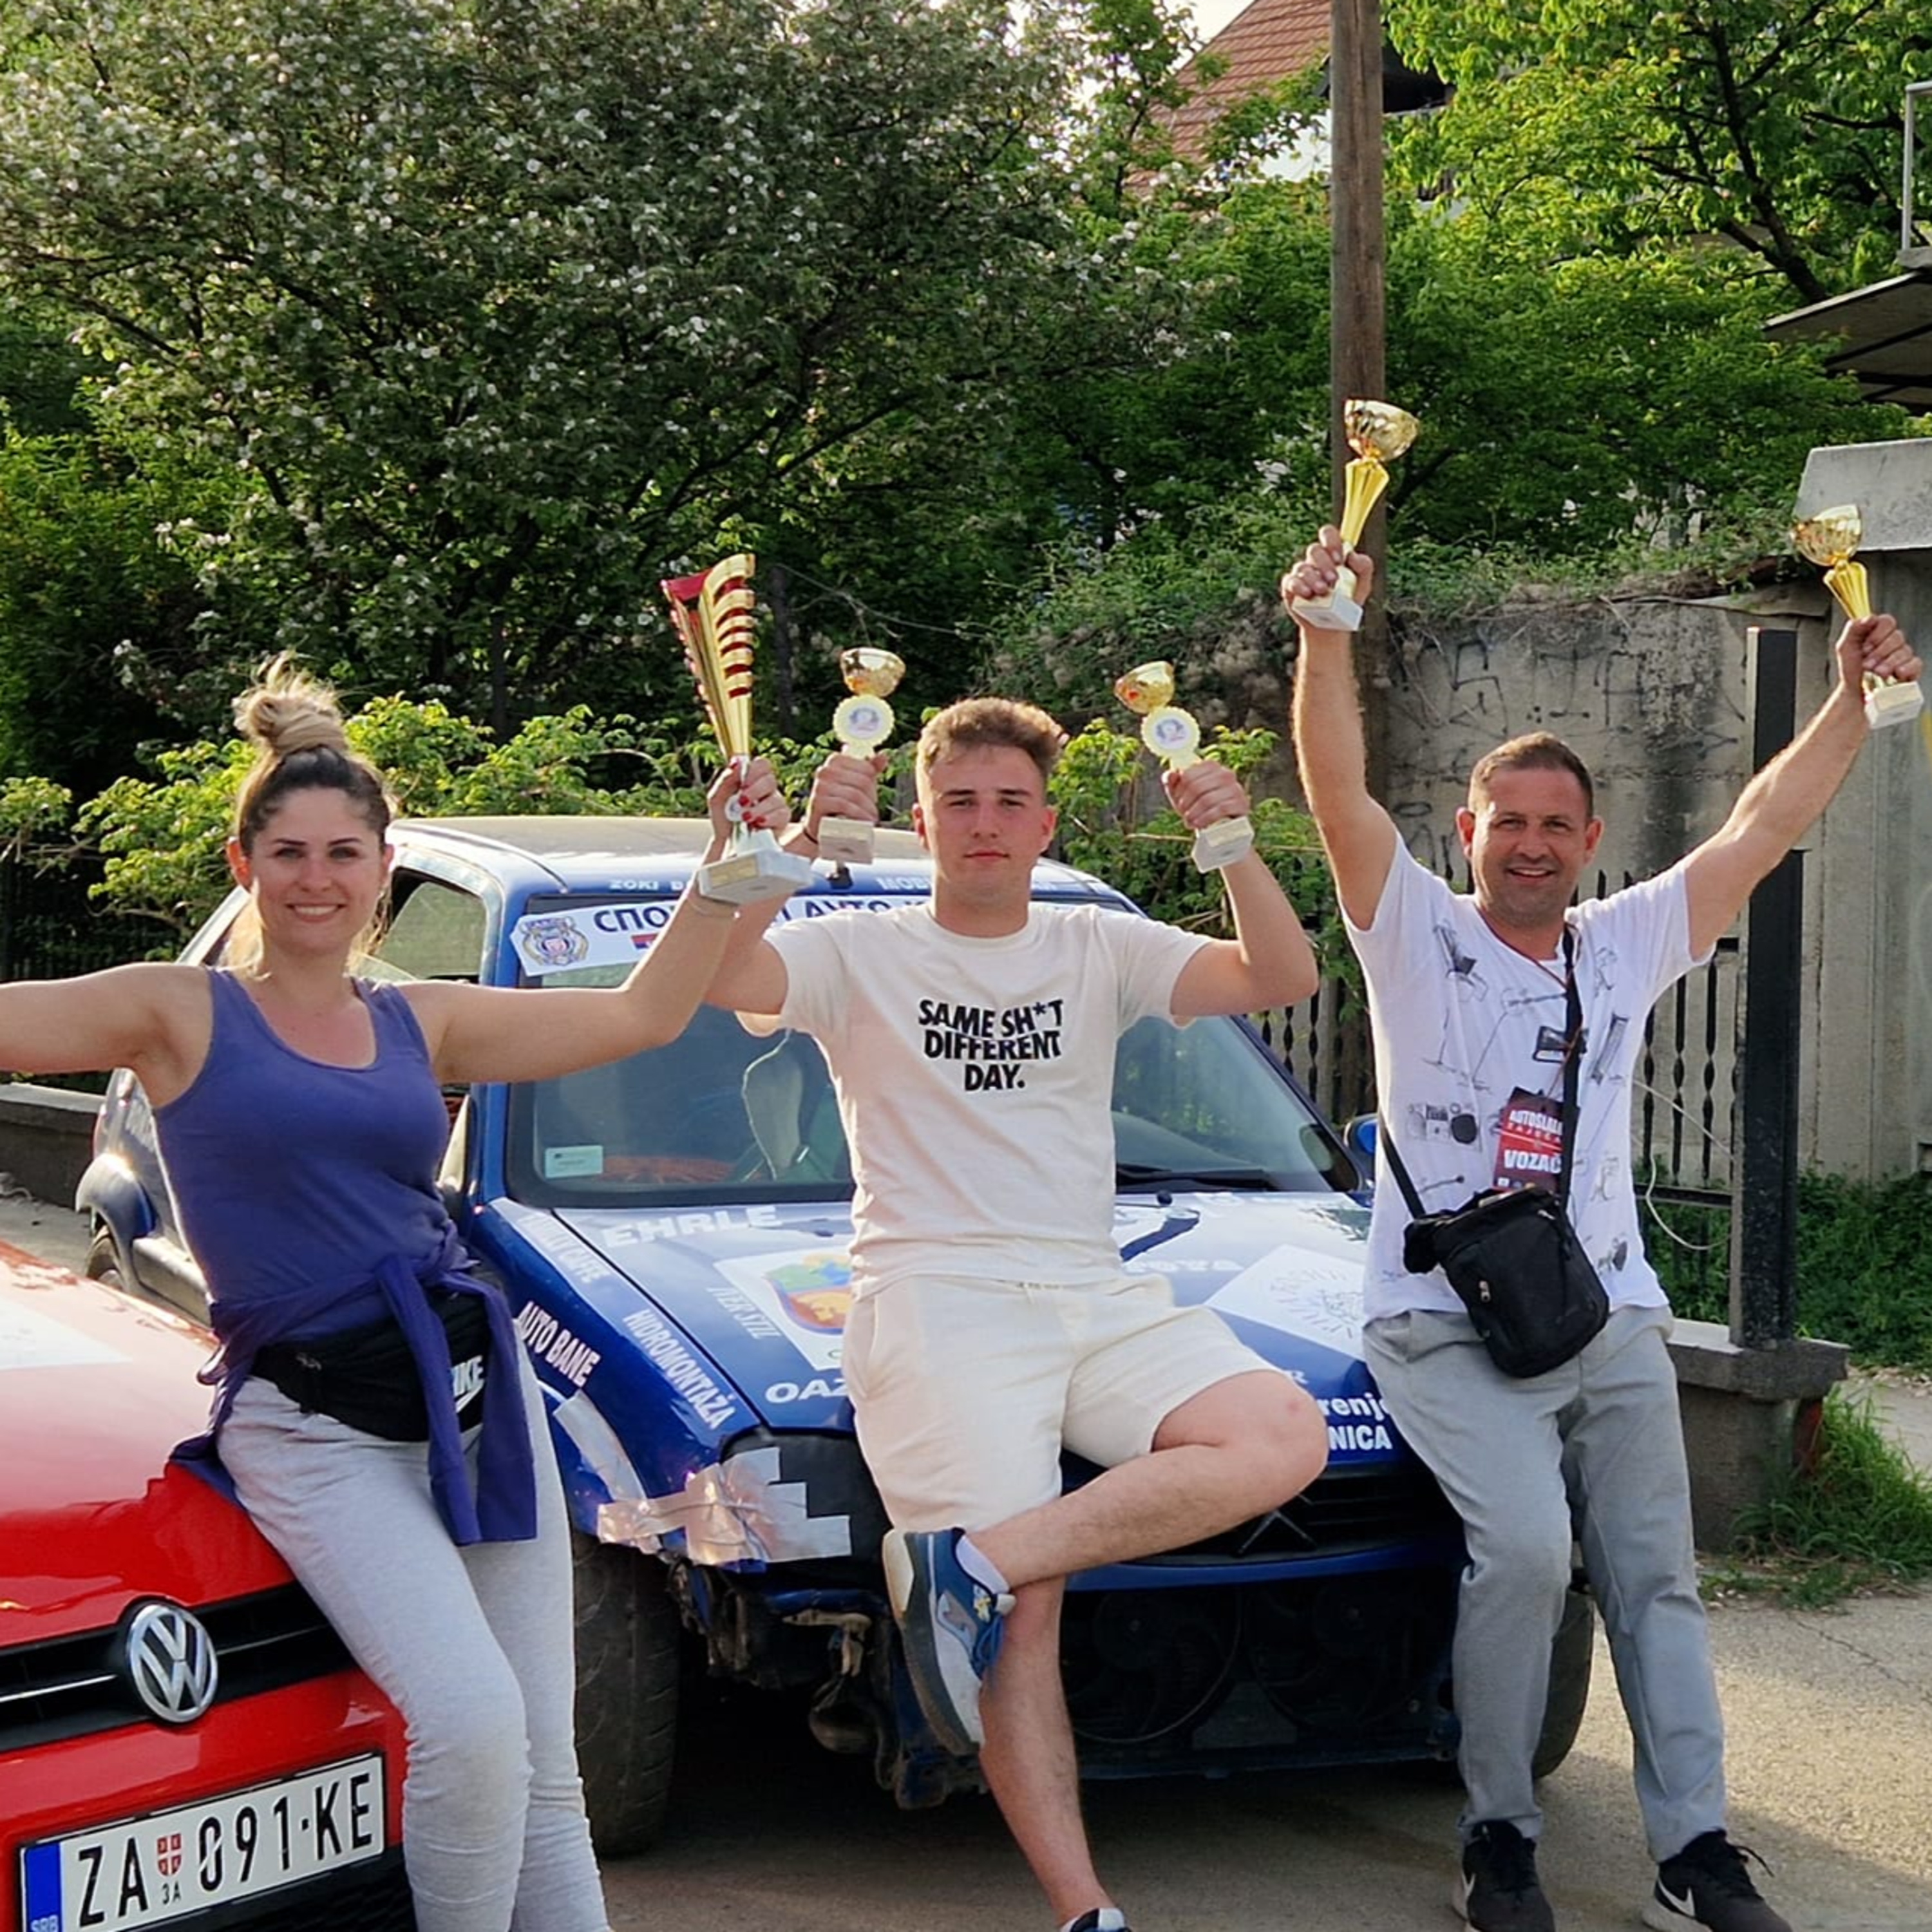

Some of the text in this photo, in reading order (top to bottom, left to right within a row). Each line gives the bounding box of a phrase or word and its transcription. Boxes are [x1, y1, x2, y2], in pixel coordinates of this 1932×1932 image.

[609, 879, 659, 891] ZOKI
[874, 876, 931, 891] MOB
[594, 906, 674, 933] СПО
[919, 999, 996, 1037] SAME
[924, 1029, 1062, 1061] DIFFERENT
[965, 1064, 1025, 1091] DAY.
[1504, 1148, 1562, 1174] VOZAČ
[602, 1205, 782, 1247] EHRLE
[516, 1301, 601, 1388] AUTO BANE
[451, 1355, 484, 1397] IKE
[1317, 1392, 1388, 1421] renj
[78, 1837, 148, 1927] ZA
[31, 1915, 59, 1932] SRB
